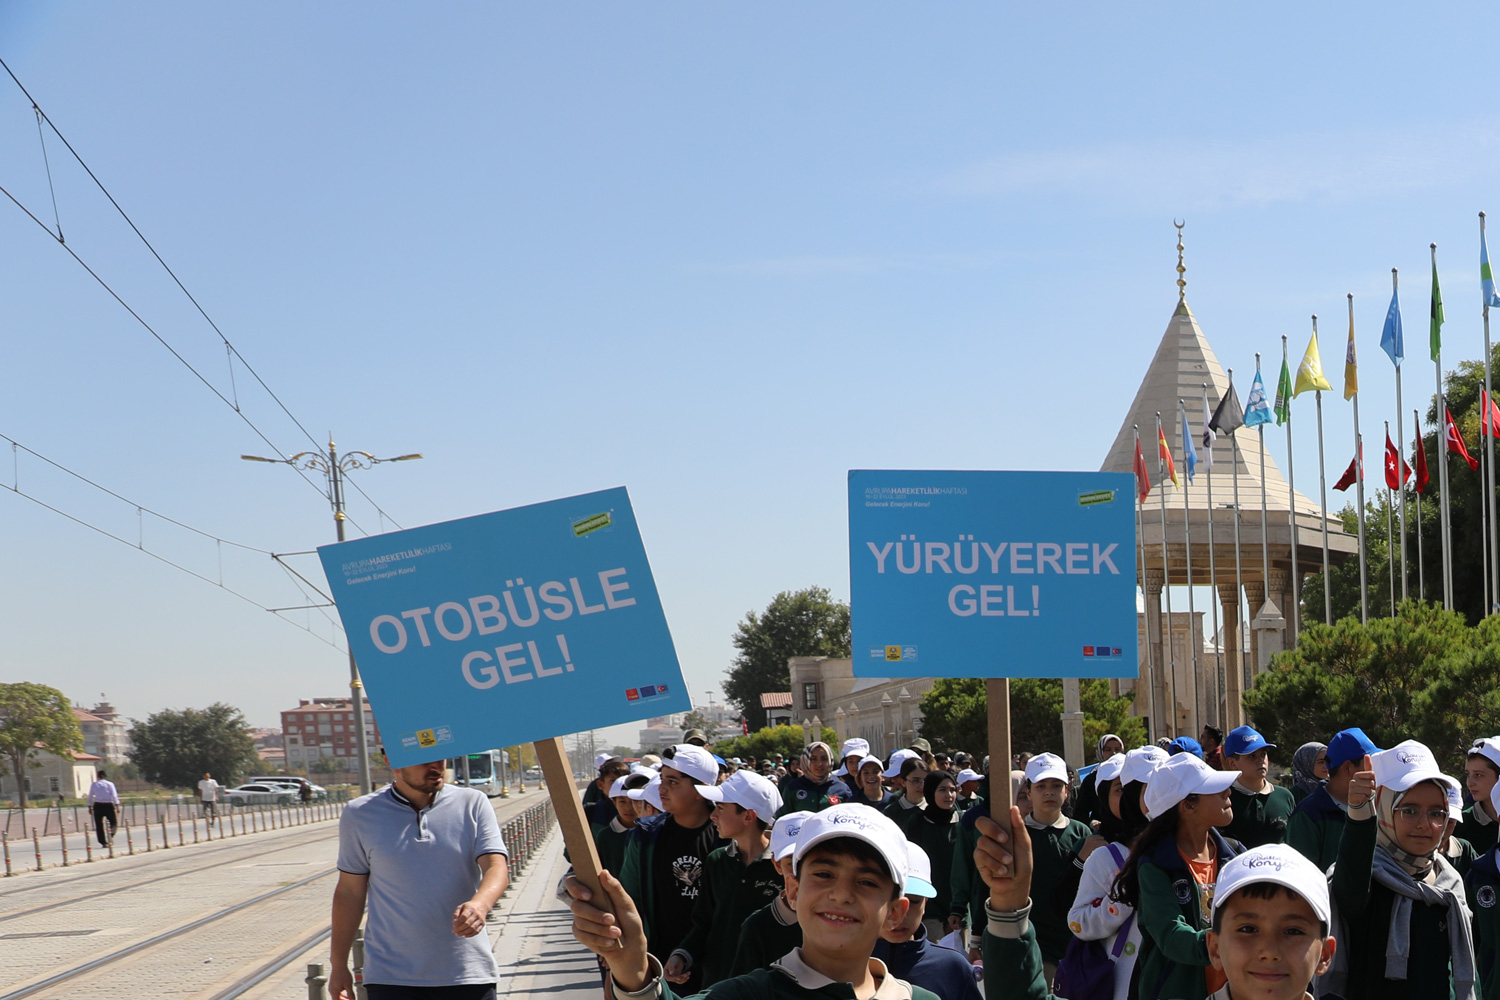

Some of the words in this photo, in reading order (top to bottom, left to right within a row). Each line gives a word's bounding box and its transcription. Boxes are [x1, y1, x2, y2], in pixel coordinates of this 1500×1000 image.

[890, 501, 912, 509] Enerjini
[866, 534, 1121, 575] YÜRÜYEREK
[346, 575, 372, 586] Gelecek
[373, 570, 398, 580] Enerjini
[399, 565, 417, 575] Koru!
[369, 567, 637, 655] OTOBÜSLE
[947, 584, 1040, 617] GEL!
[460, 634, 575, 690] GEL!
[672, 855, 702, 869] CREATE
[681, 886, 699, 900] Life
